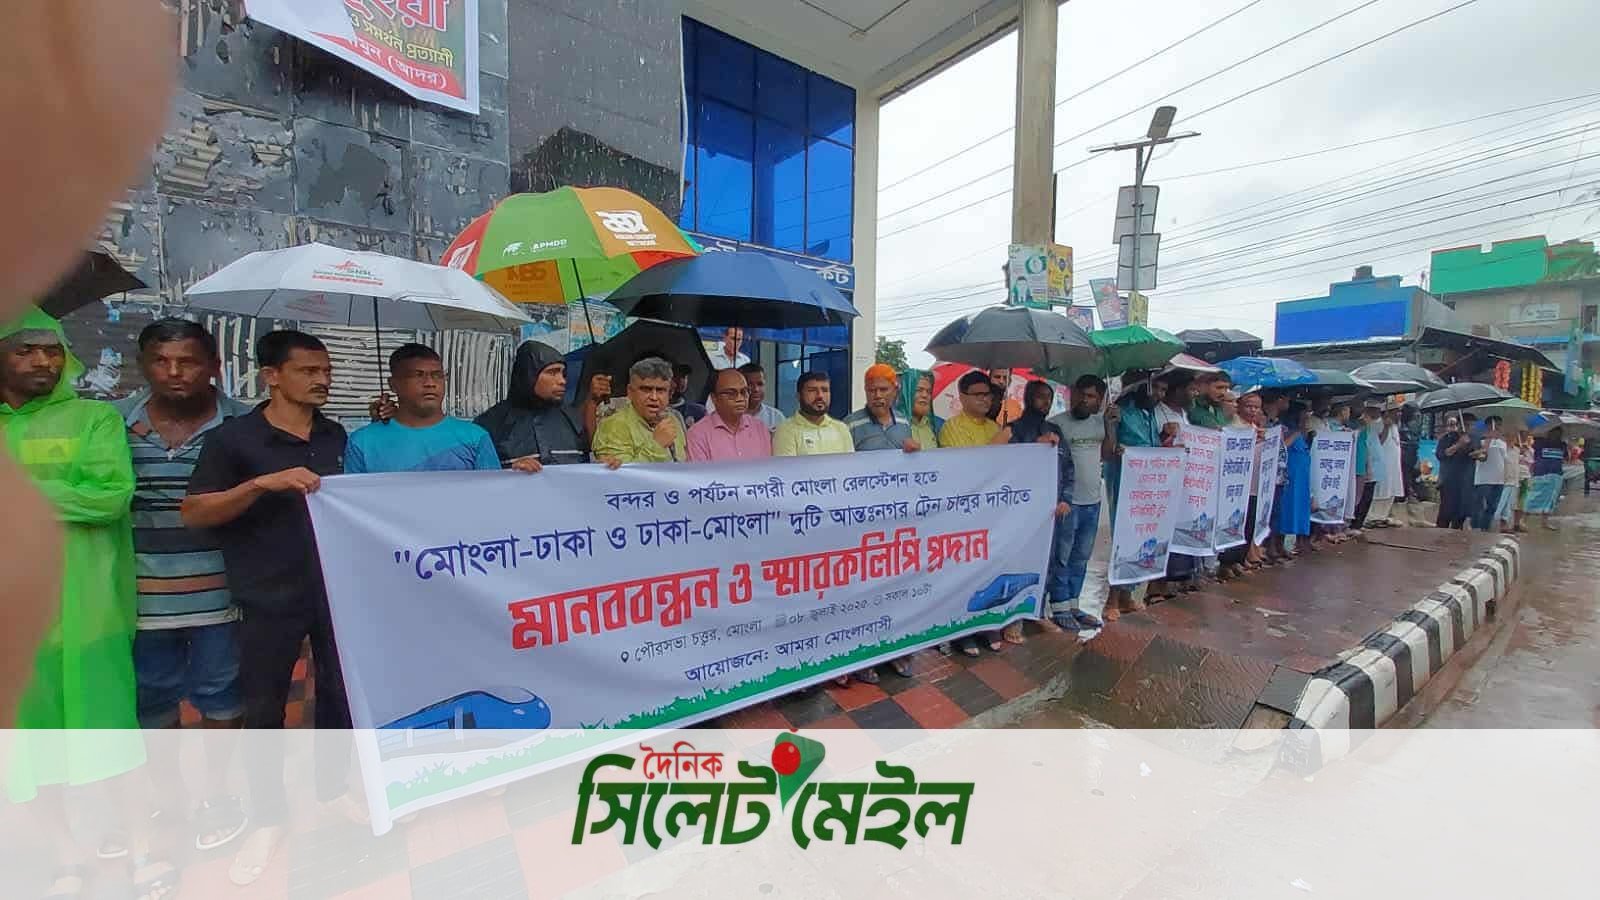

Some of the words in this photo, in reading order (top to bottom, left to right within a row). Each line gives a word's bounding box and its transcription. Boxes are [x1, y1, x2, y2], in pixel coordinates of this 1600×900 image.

[362, 20, 403, 53] সমর্থন
[406, 43, 454, 69] প্রত্যাশী
[605, 490, 656, 511] বন্দর
[664, 489, 679, 505] ও
[688, 481, 739, 504] পর্যটন
[746, 477, 784, 499] নগরী
[791, 477, 837, 498] মোংলা
[843, 471, 909, 492] রেলস্টেশন
[914, 470, 939, 485] হতে
[607, 526, 627, 550] ও
[789, 504, 824, 536] দুটি
[831, 500, 909, 527] আন্তঃনগর
[915, 495, 941, 518] ট্রেন
[947, 493, 980, 515] চালুর
[986, 486, 1031, 508] দাবীতে
[508, 567, 720, 650] মানববন্ধন
[728, 563, 753, 605] ও
[761, 527, 921, 600] স্মারকলিপি
[927, 528, 989, 572] প্রদান
[635, 635, 687, 661] পৌরসভা
[726, 619, 762, 637] মোংলা
[775, 634, 819, 656] আমরা
[825, 616, 892, 646] মোংলাবাসী
